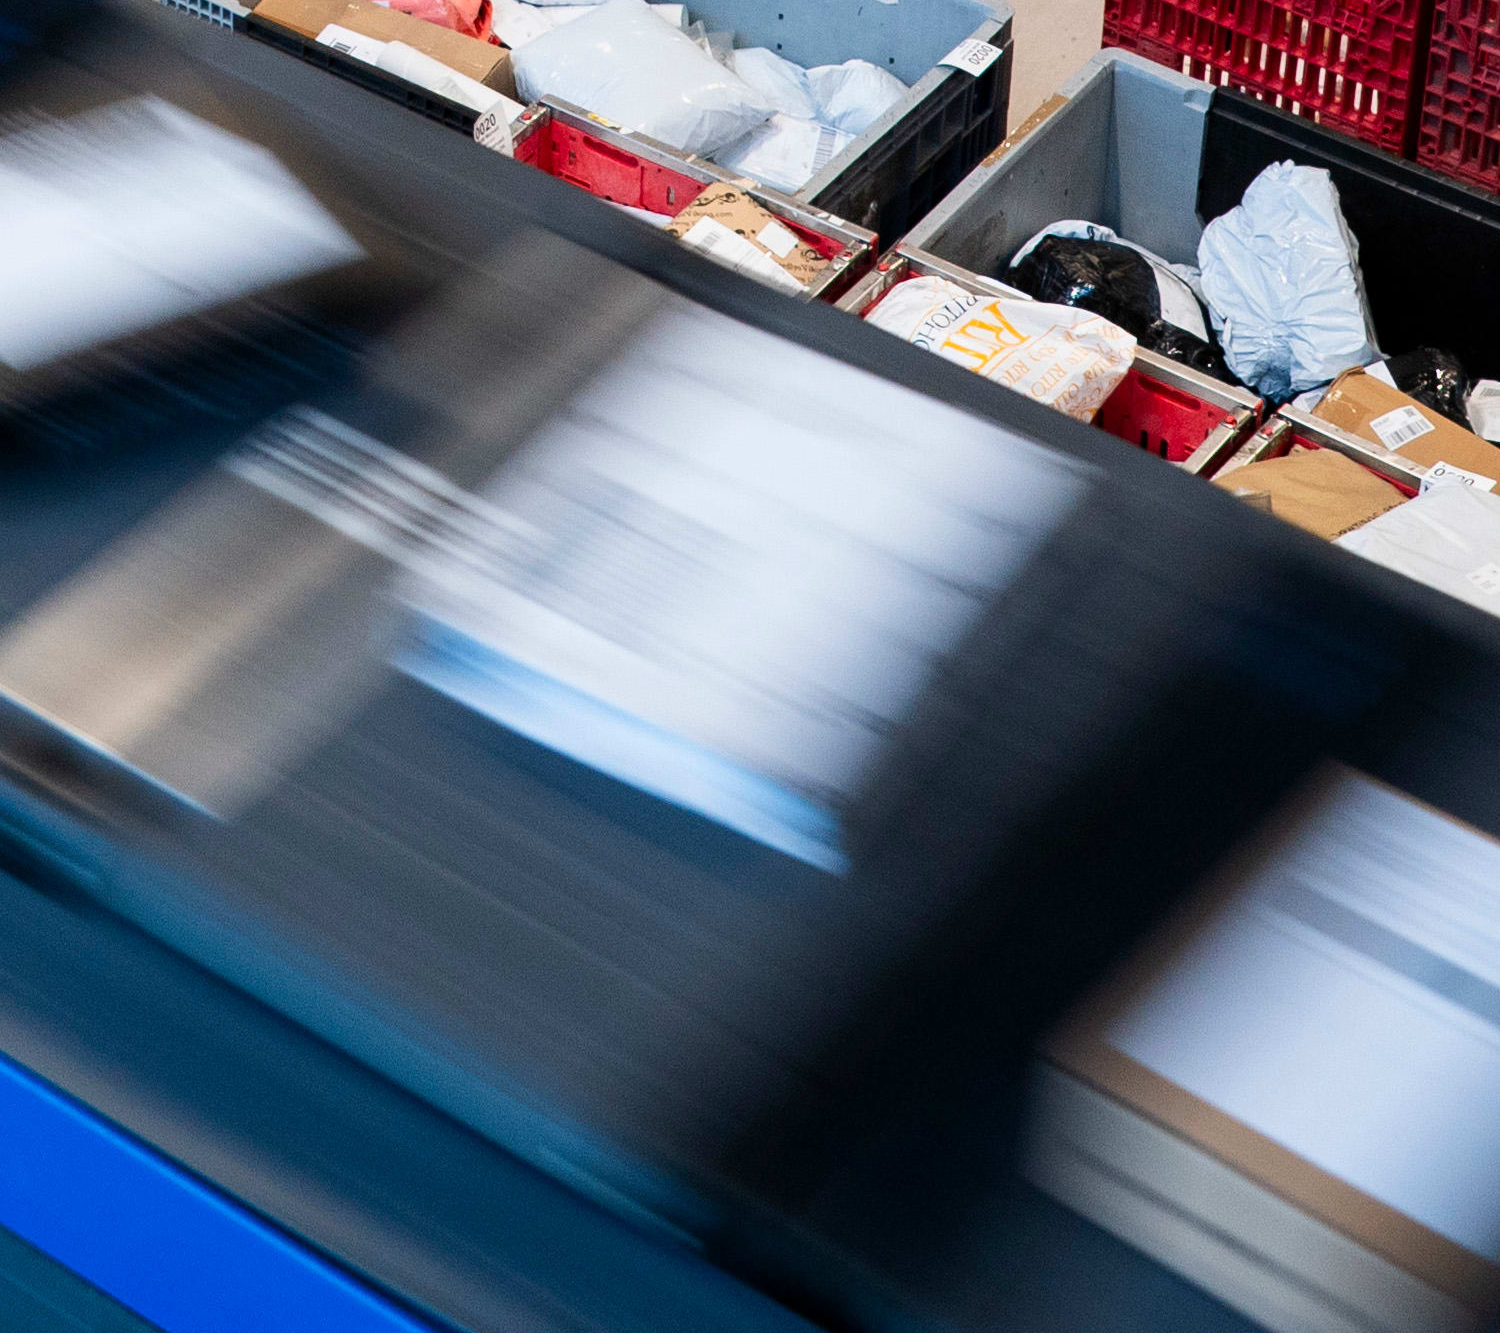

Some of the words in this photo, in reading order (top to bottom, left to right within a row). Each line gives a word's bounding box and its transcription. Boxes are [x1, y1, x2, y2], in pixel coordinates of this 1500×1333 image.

[967, 45, 993, 67] 0020
[475, 113, 498, 141] 0020
[1031, 364, 1070, 398] RITO
